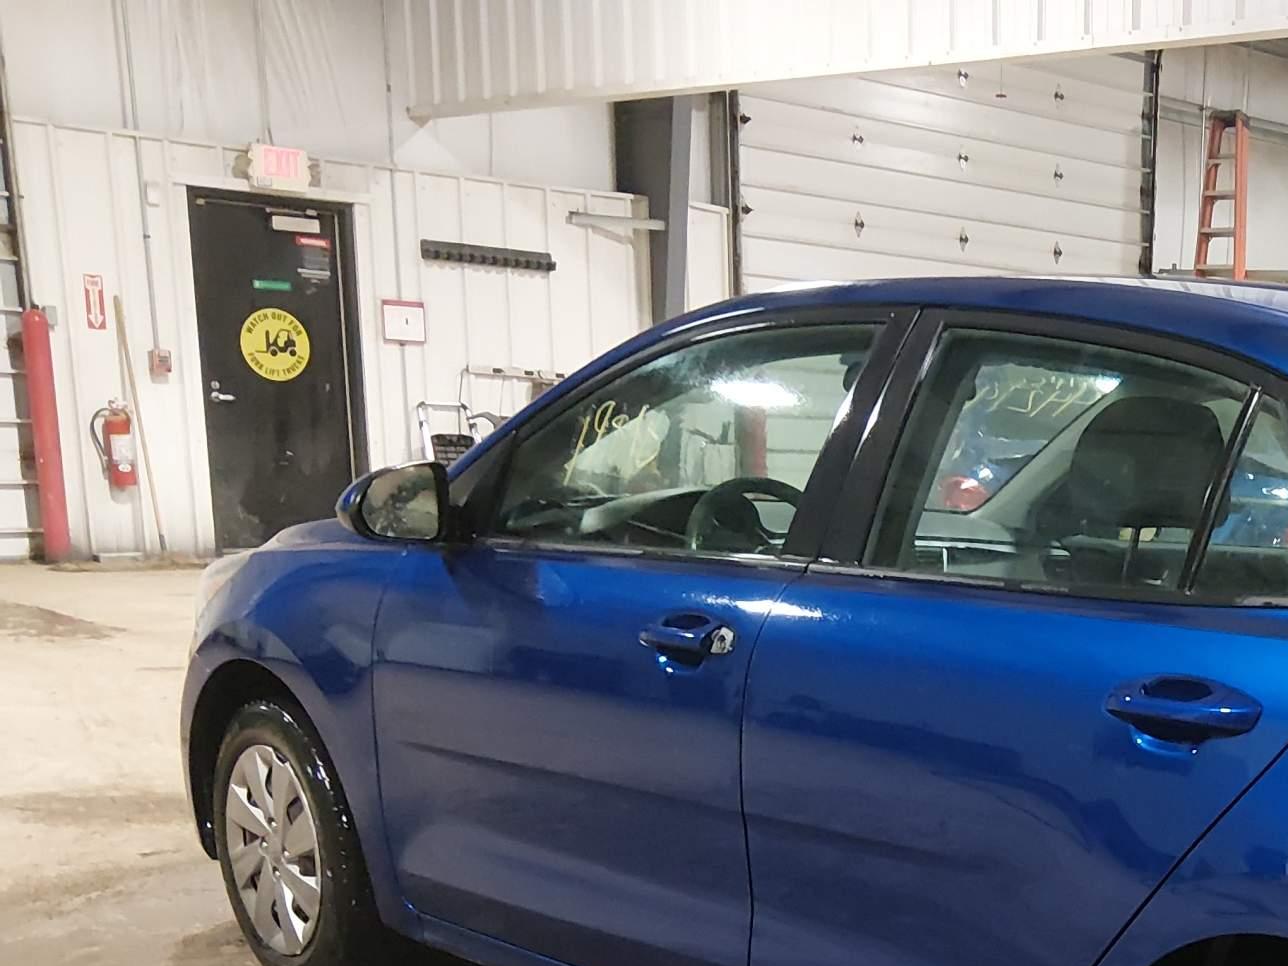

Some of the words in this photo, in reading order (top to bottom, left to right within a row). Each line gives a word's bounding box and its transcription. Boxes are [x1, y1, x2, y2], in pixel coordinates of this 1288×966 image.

[263, 148, 302, 177] EXIT
[246, 311, 270, 335] WATCH
[271, 311, 287, 323] OUT
[288, 318, 303, 337] FOR
[282, 354, 306, 377] TRUCKS
